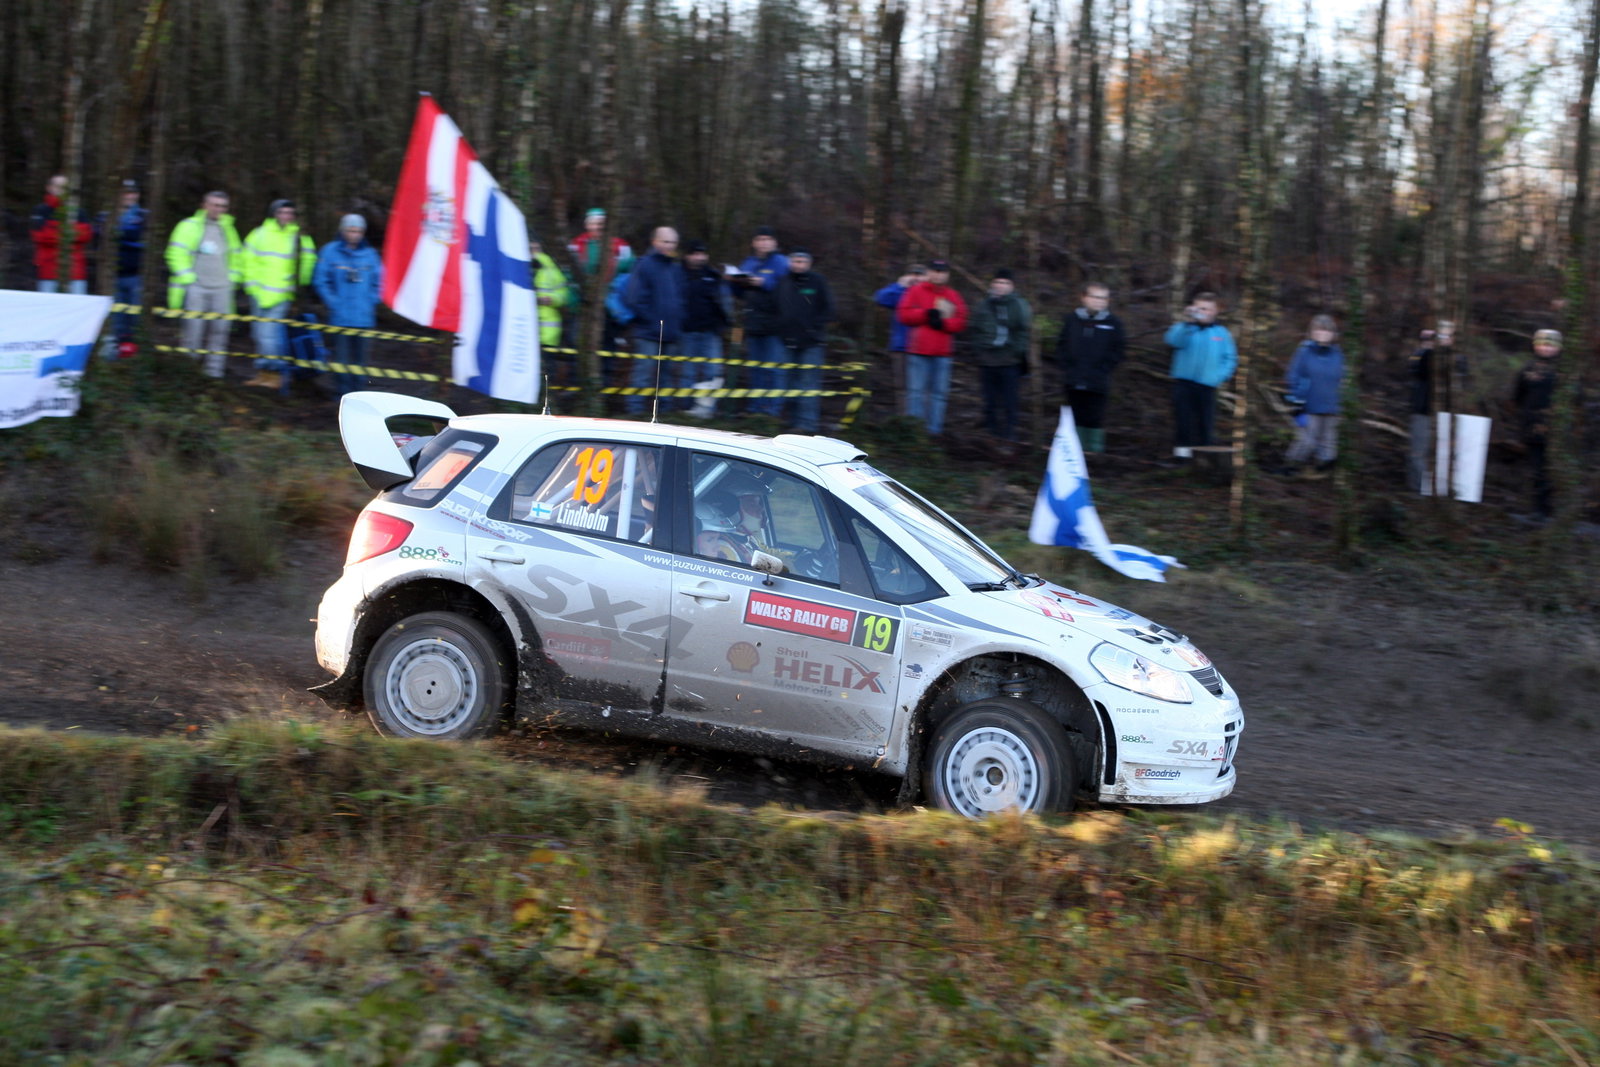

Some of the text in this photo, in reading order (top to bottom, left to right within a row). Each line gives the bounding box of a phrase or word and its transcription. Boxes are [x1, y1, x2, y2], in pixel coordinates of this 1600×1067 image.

[572, 447, 614, 505] 19
[440, 500, 533, 542] SUZUKI SPORT
[556, 502, 609, 532] Lindholm
[643, 553, 754, 582] WWW.SUZUKI-WRC.COM
[506, 564, 694, 660] SX4
[750, 600, 849, 633] WALES RALLY GB
[863, 615, 892, 651] 19
[776, 646, 808, 659] Shell
[773, 679, 833, 697] Motor oils
[774, 655, 882, 694] HELIX
[1166, 740, 1208, 756] SX4
[1134, 768, 1181, 779] BFGoodrich
